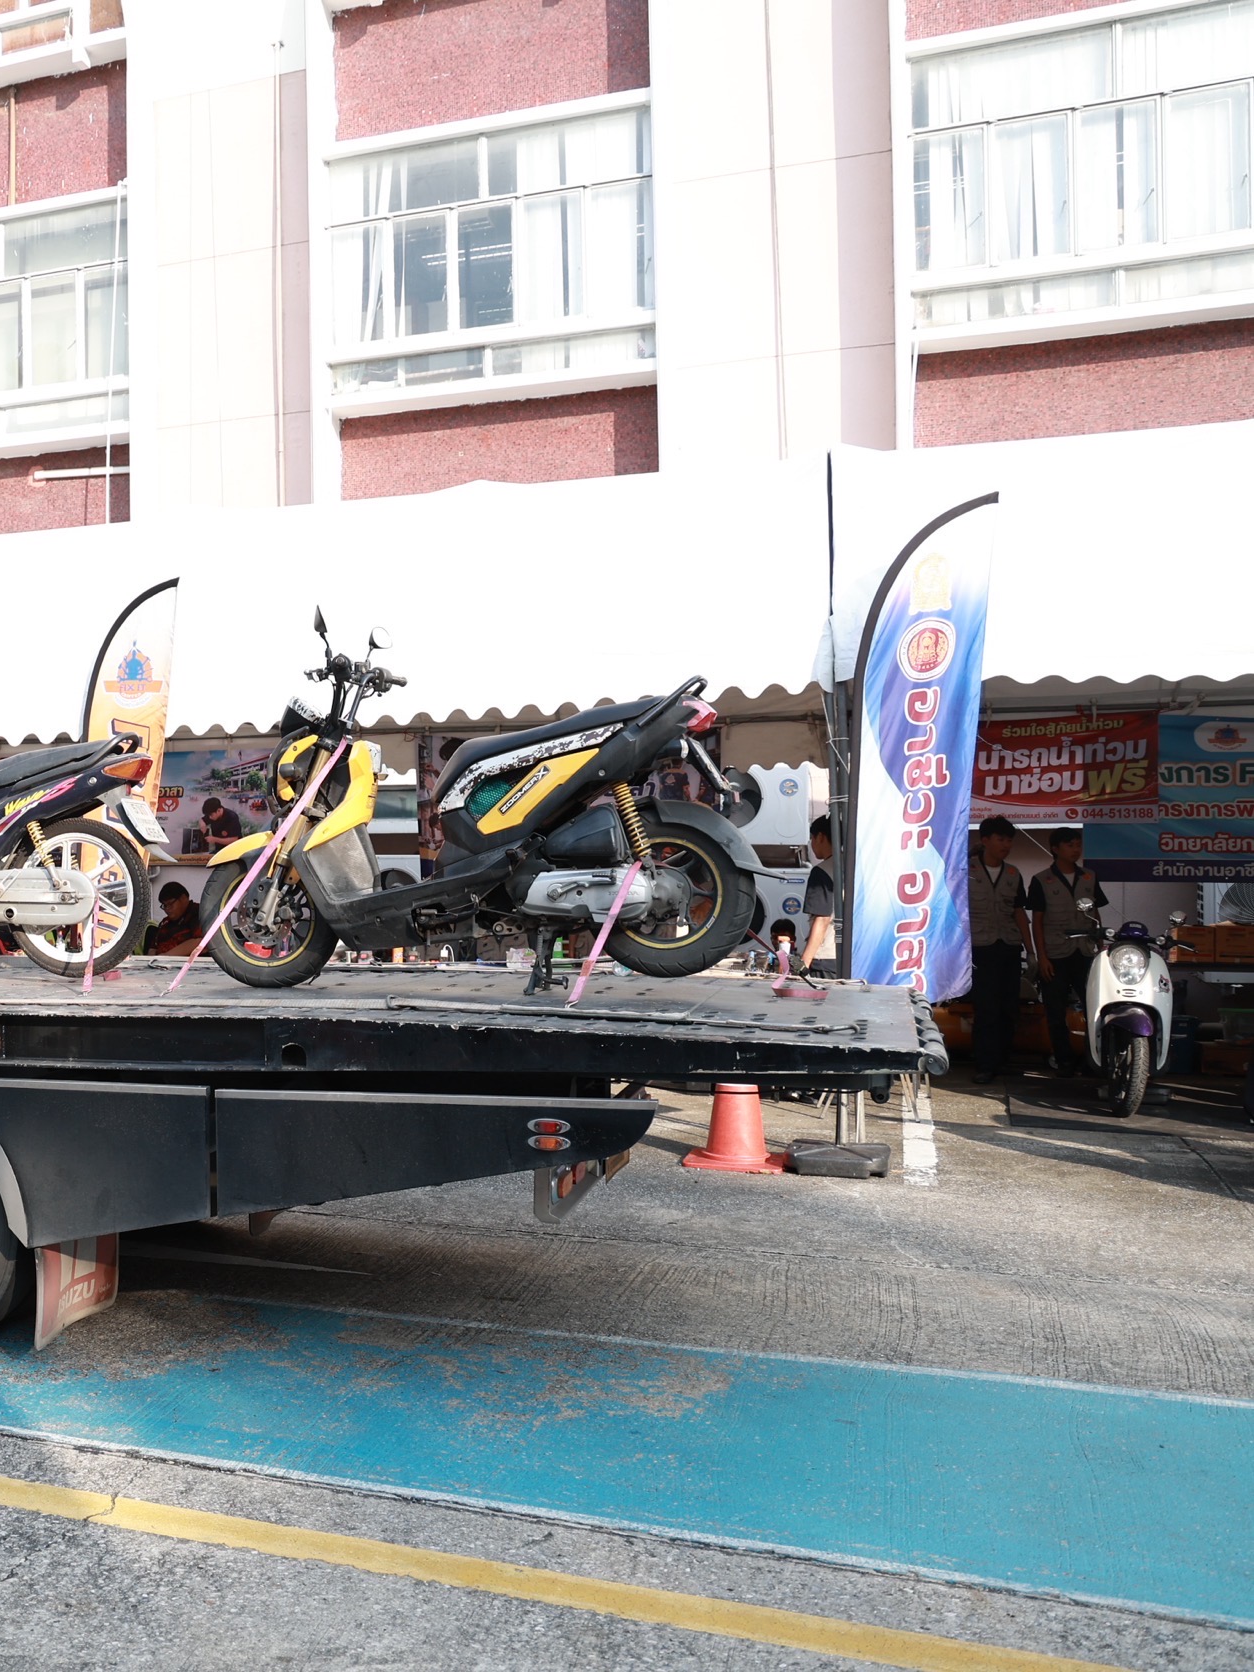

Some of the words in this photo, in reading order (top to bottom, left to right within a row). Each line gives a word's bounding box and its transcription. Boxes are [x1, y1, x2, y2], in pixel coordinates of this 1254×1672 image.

[120, 683, 134, 691] FIX
[137, 683, 146, 691] IT
[985, 768, 1084, 796] มาซ่อม
[1088, 760, 1149, 796] ฟรี
[1159, 764, 1230, 783] งการ
[1082, 807, 1153, 819] 044-513188
[57, 1278, 95, 1318] ISUZU
